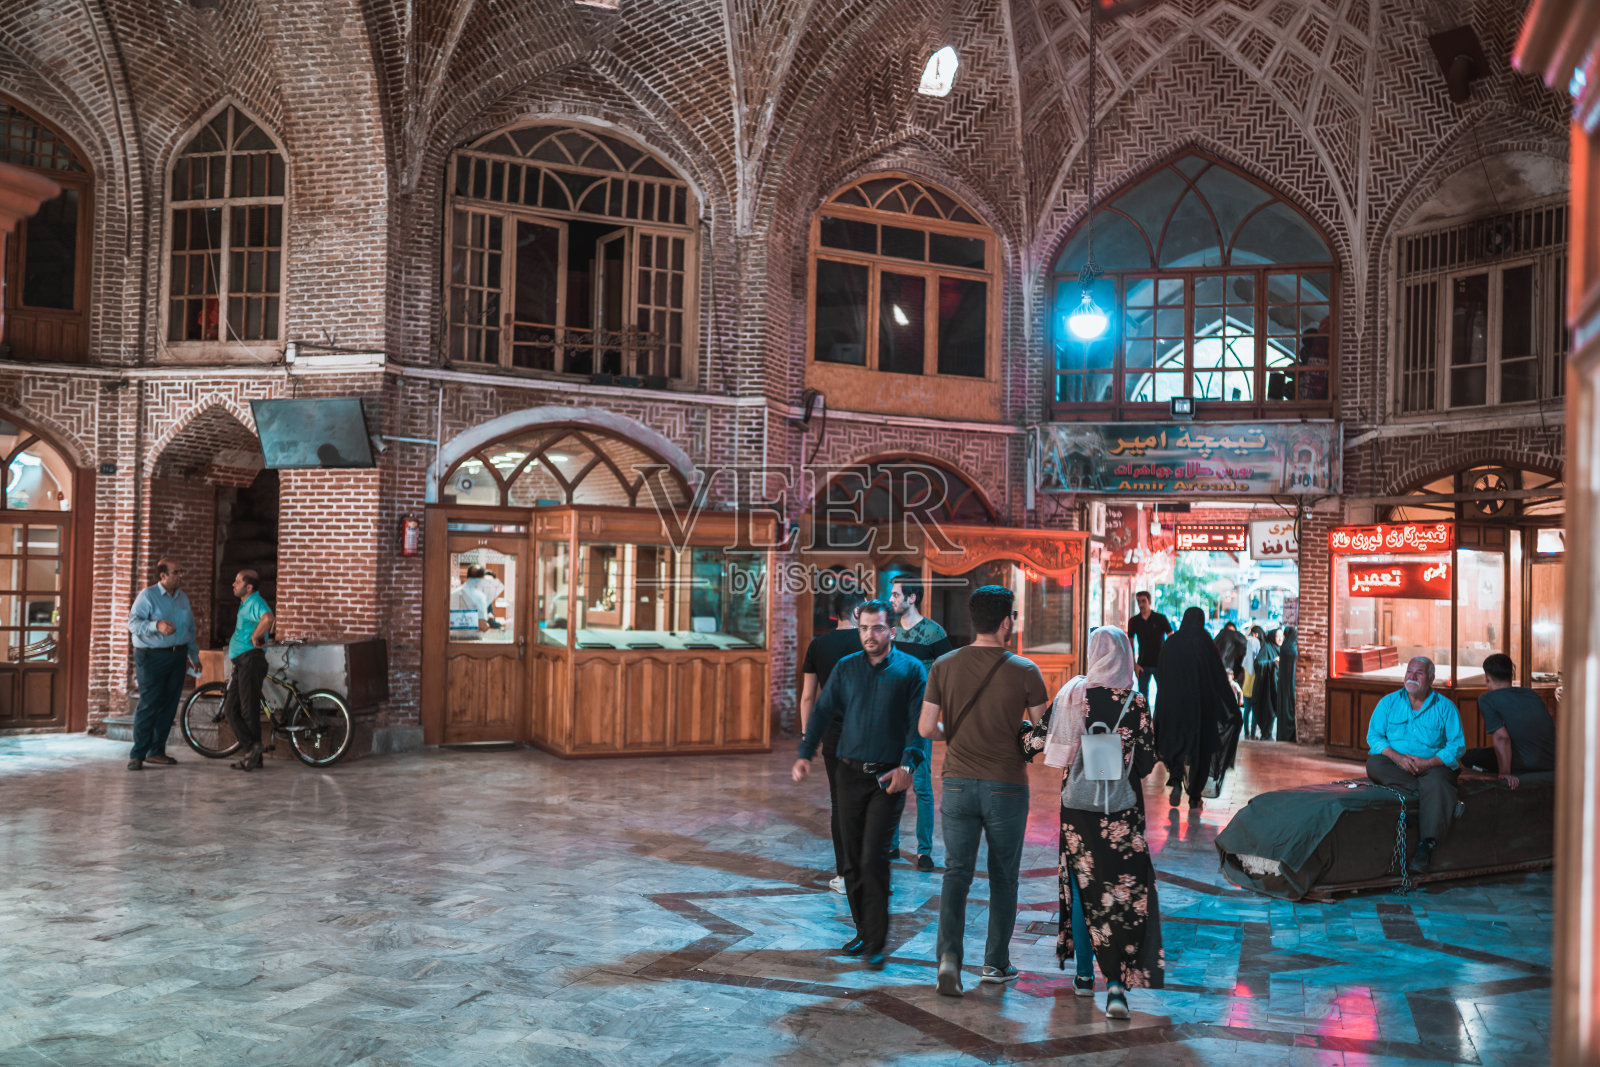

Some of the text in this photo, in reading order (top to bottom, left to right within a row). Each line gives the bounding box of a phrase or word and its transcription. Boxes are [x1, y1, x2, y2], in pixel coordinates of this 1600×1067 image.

[1107, 430, 1167, 455] امیر
[1114, 463, 1173, 478] جواهرات
[1175, 467, 1184, 478] و
[1186, 461, 1212, 478] طلا
[1117, 480, 1250, 491] Amir Arcade
[1332, 524, 1447, 552] تعمیرکاری فوری طلا
[1351, 569, 1403, 592] تعمیر
